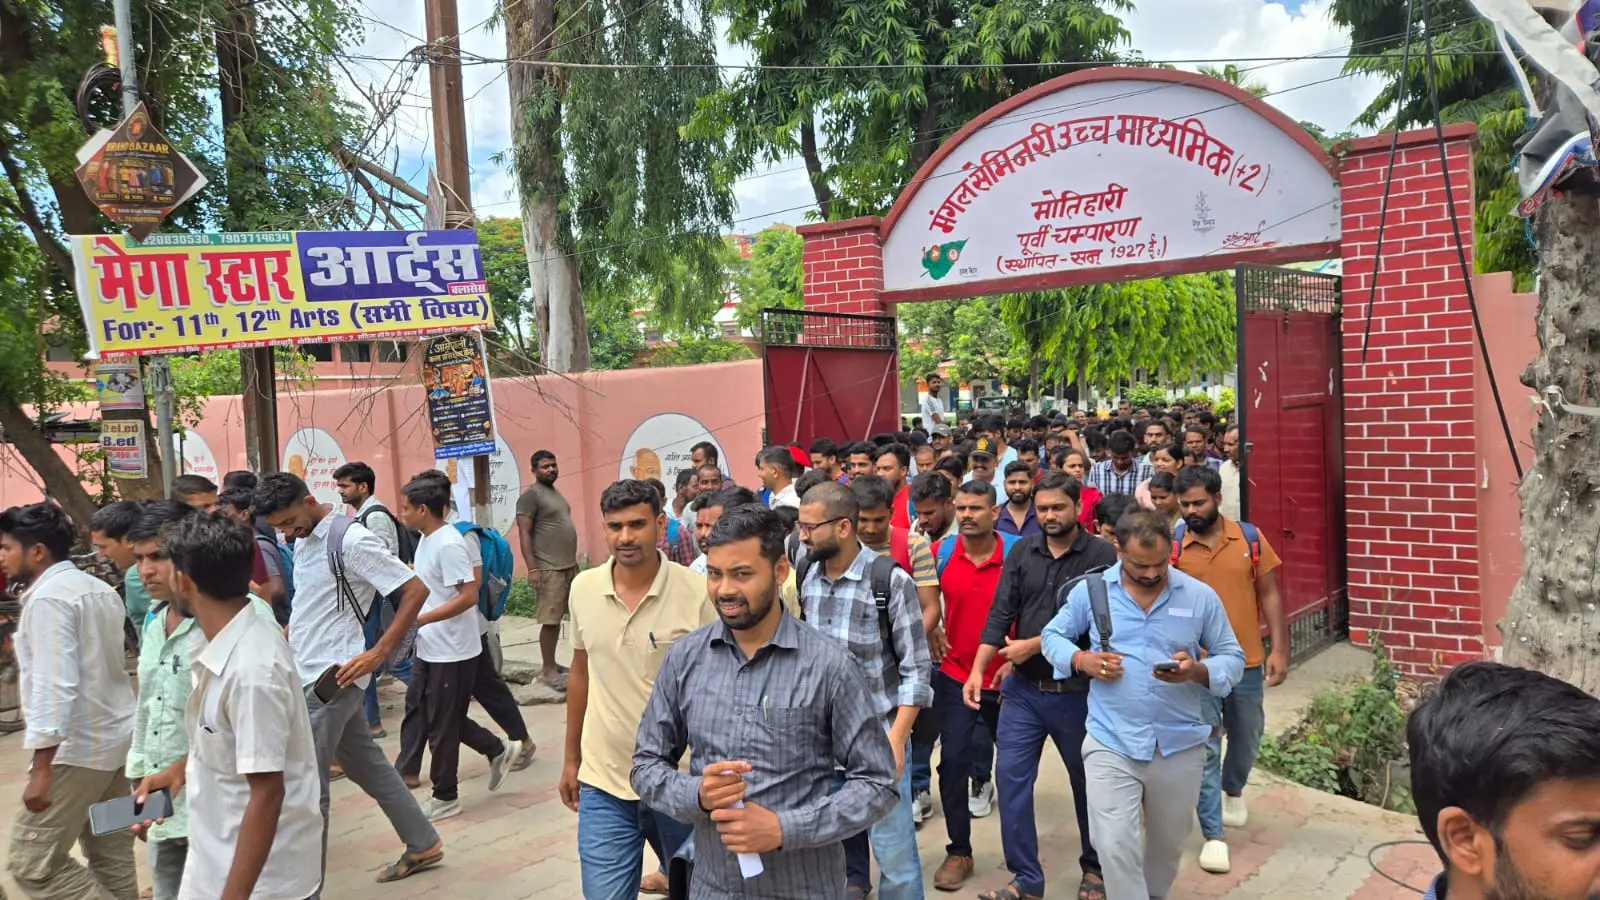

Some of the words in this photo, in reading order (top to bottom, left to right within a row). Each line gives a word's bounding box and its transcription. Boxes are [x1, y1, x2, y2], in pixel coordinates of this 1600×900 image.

[928, 178, 978, 234] मंगल
[961, 122, 1057, 191] सेमिनरी
[1056, 115, 1115, 150] उच्च
[1116, 114, 1235, 176] माध्यमिक
[1228, 153, 1271, 198] (+2)
[1031, 183, 1128, 220] मोतिहारी
[220, 232, 289, 244] 7903714634
[1017, 223, 1053, 256] पूर्वी
[1051, 216, 1142, 244] चम्पारण
[1111, 243, 1146, 258] 1927
[93, 236, 191, 310] मेगा
[200, 250, 294, 305] स्टार
[306, 232, 479, 293] आर्ट्स
[103, 317, 164, 341] For:-
[172, 312, 228, 337] 11th,
[236, 308, 280, 333] 12th
[289, 307, 340, 329] Arts
[350, 300, 412, 329] (सभी
[418, 295, 489, 321] विषय)
[103, 435, 136, 446] B.ed
